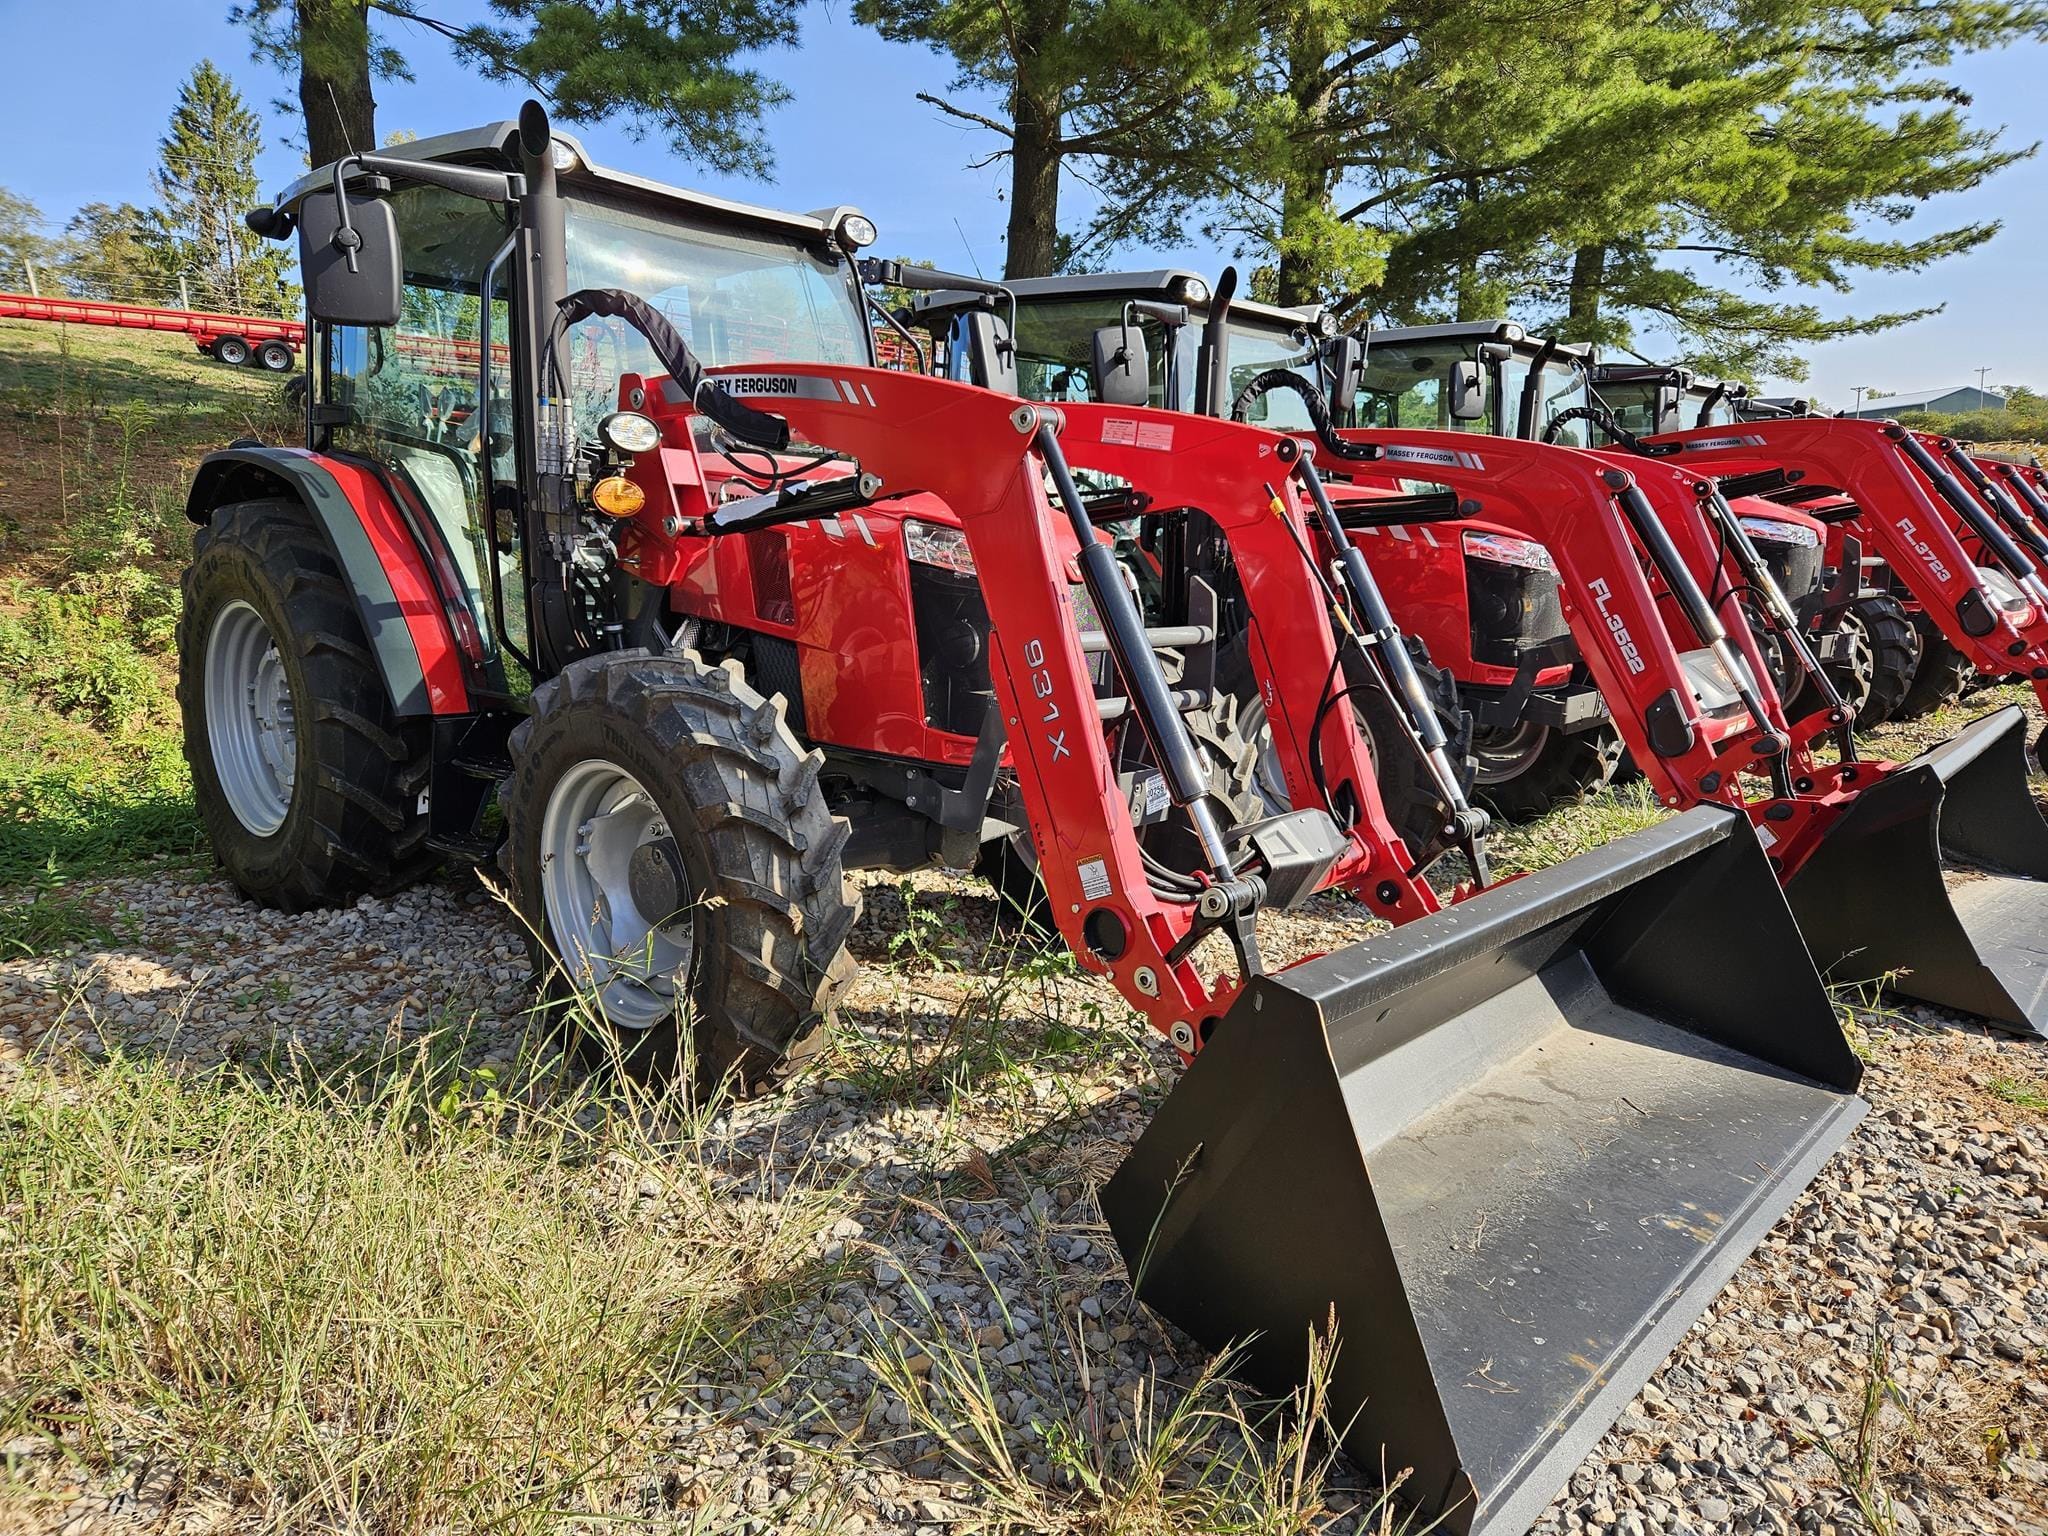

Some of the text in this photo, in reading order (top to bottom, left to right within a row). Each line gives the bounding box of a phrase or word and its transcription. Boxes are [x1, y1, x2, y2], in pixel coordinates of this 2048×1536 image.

[735, 377, 797, 394] FERGUSON
[1710, 439, 1740, 447] FERGUSON
[1387, 449, 1454, 462] MASSEY FERGUSON
[1895, 517, 1952, 583] FL.3723
[1587, 577, 1646, 675] FL.3522
